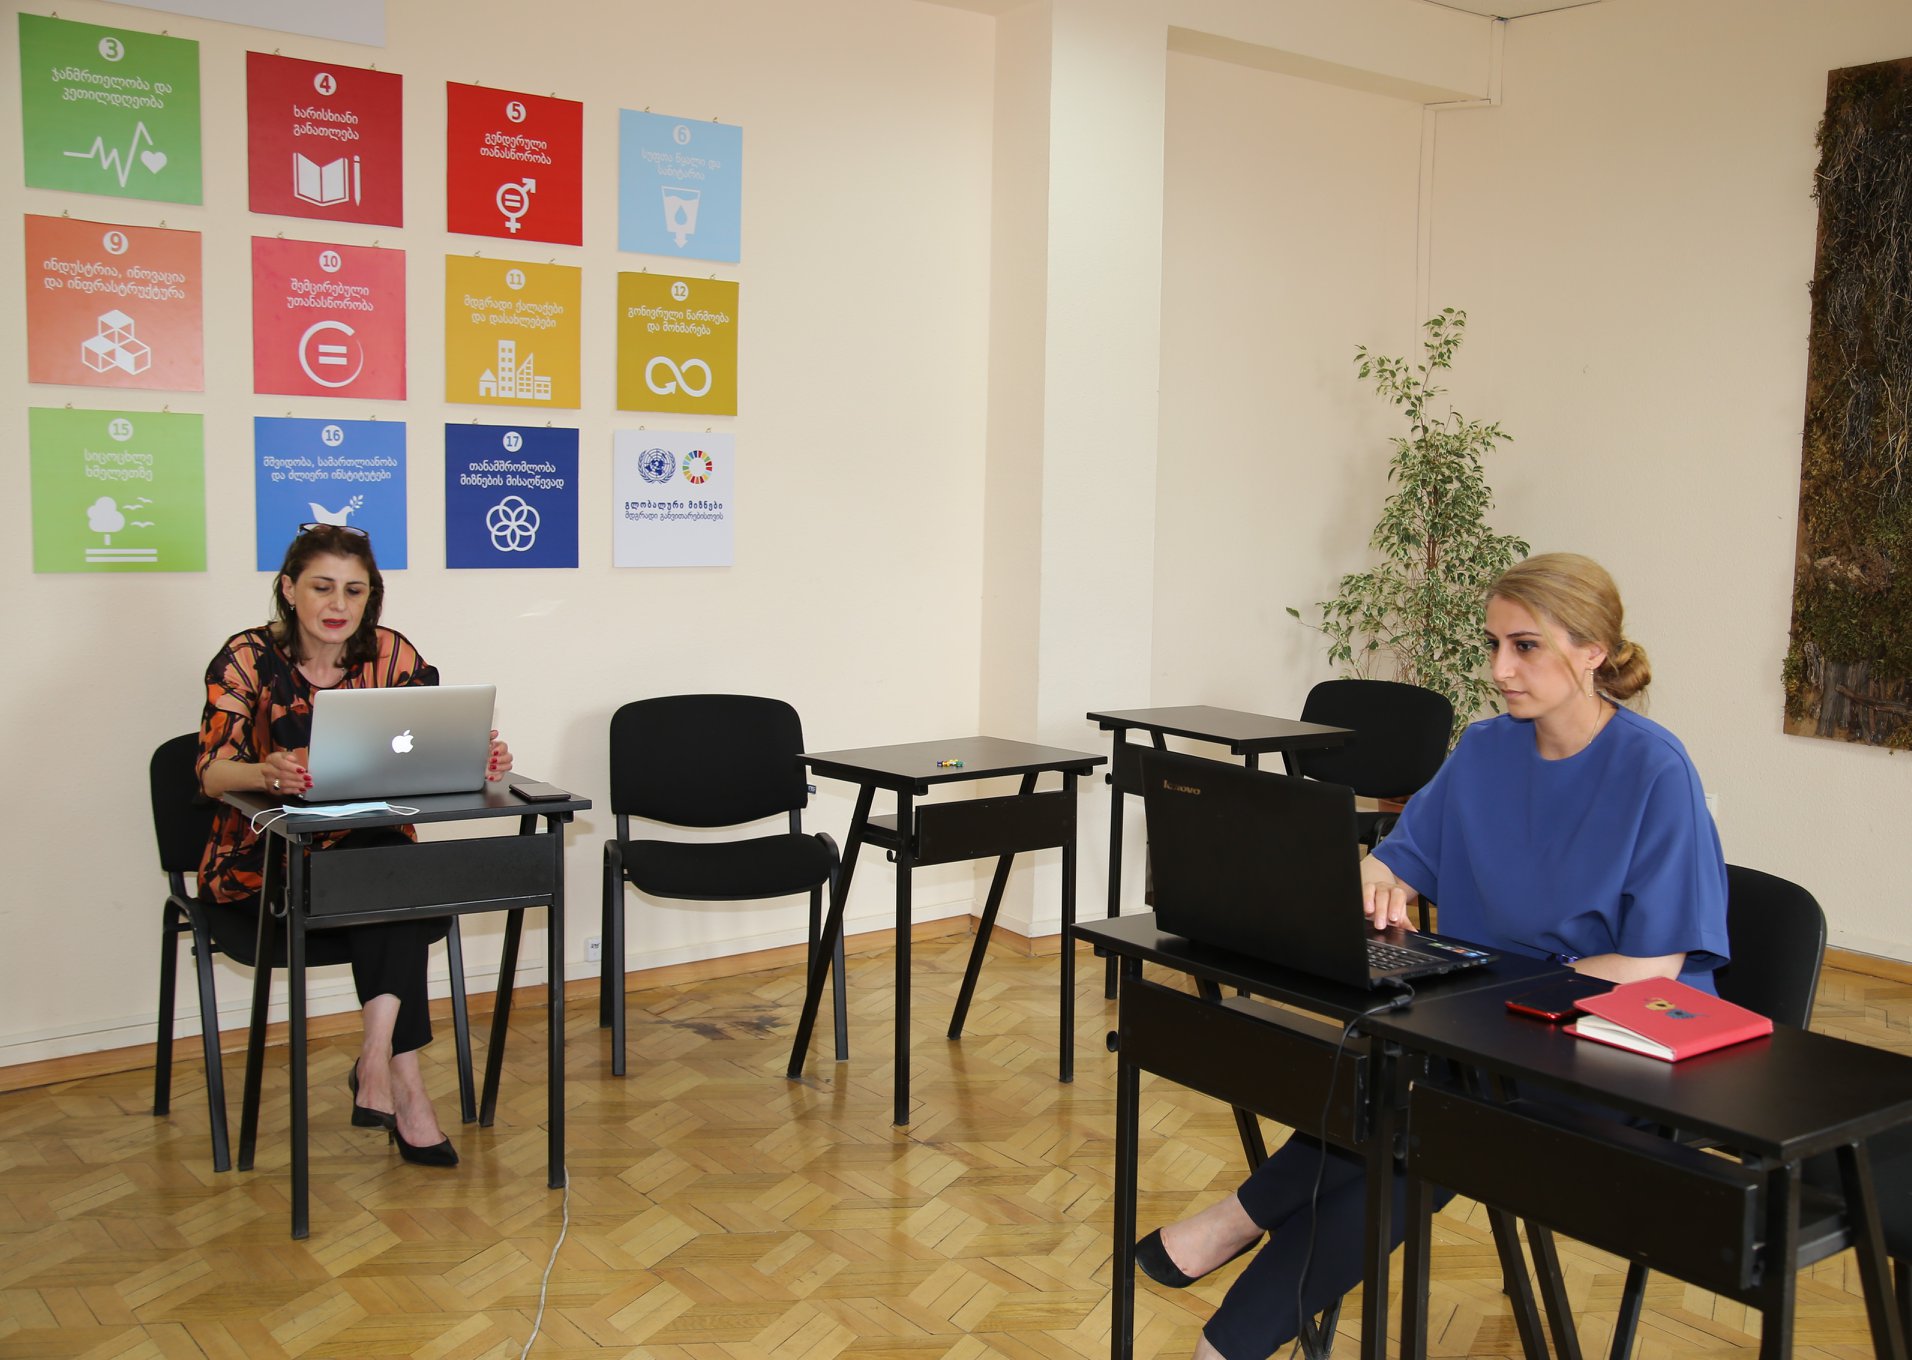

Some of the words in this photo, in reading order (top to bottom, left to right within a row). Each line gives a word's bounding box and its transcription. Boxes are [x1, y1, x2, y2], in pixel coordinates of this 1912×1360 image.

[51, 67, 150, 90] ჯანმრთელობა
[154, 82, 173, 95] და
[62, 87, 164, 109] კეთილდღეობა
[293, 105, 358, 124] ხარისხიანი
[293, 122, 360, 141] განათლება
[485, 131, 547, 151] გენდერული
[480, 146, 552, 165] თანასწორობა
[44, 257, 122, 278] ინდუსტრია,
[127, 265, 185, 284] ინოვაცია
[44, 277, 63, 290] და
[68, 277, 185, 300] ინფრასტრუქტურა
[291, 278, 369, 298] შემცირებული
[287, 295, 374, 312] უთანასწორობა
[464, 294, 512, 311] მდგრადი
[516, 300, 564, 316] ქალაქები
[472, 312, 486, 324] და
[490, 312, 556, 330] დასახლებები
[628, 305, 684, 321] გონივრული
[686, 309, 730, 325] წარმოება
[647, 322, 660, 333] და
[663, 321, 711, 337] მოხმარება
[84, 448, 153, 465] სიცოცხლე
[263, 456, 314, 469] მშვიდობა,
[317, 456, 397, 469] სამართლიანობა
[85, 464, 153, 482] ხმელეთზე
[271, 471, 285, 482] და
[288, 469, 328, 482] ძლიერი
[331, 469, 391, 482] ინსტიტუტები
[469, 460, 556, 475] თანამშრომლობა
[460, 473, 503, 488] მიზნების
[506, 475, 564, 489] მისაღწევად
[625, 500, 684, 510] გლობალური
[688, 500, 723, 511] მიზნები
[625, 511, 658, 521] მდგრადი
[660, 511, 724, 521] განვითარებისთვის
